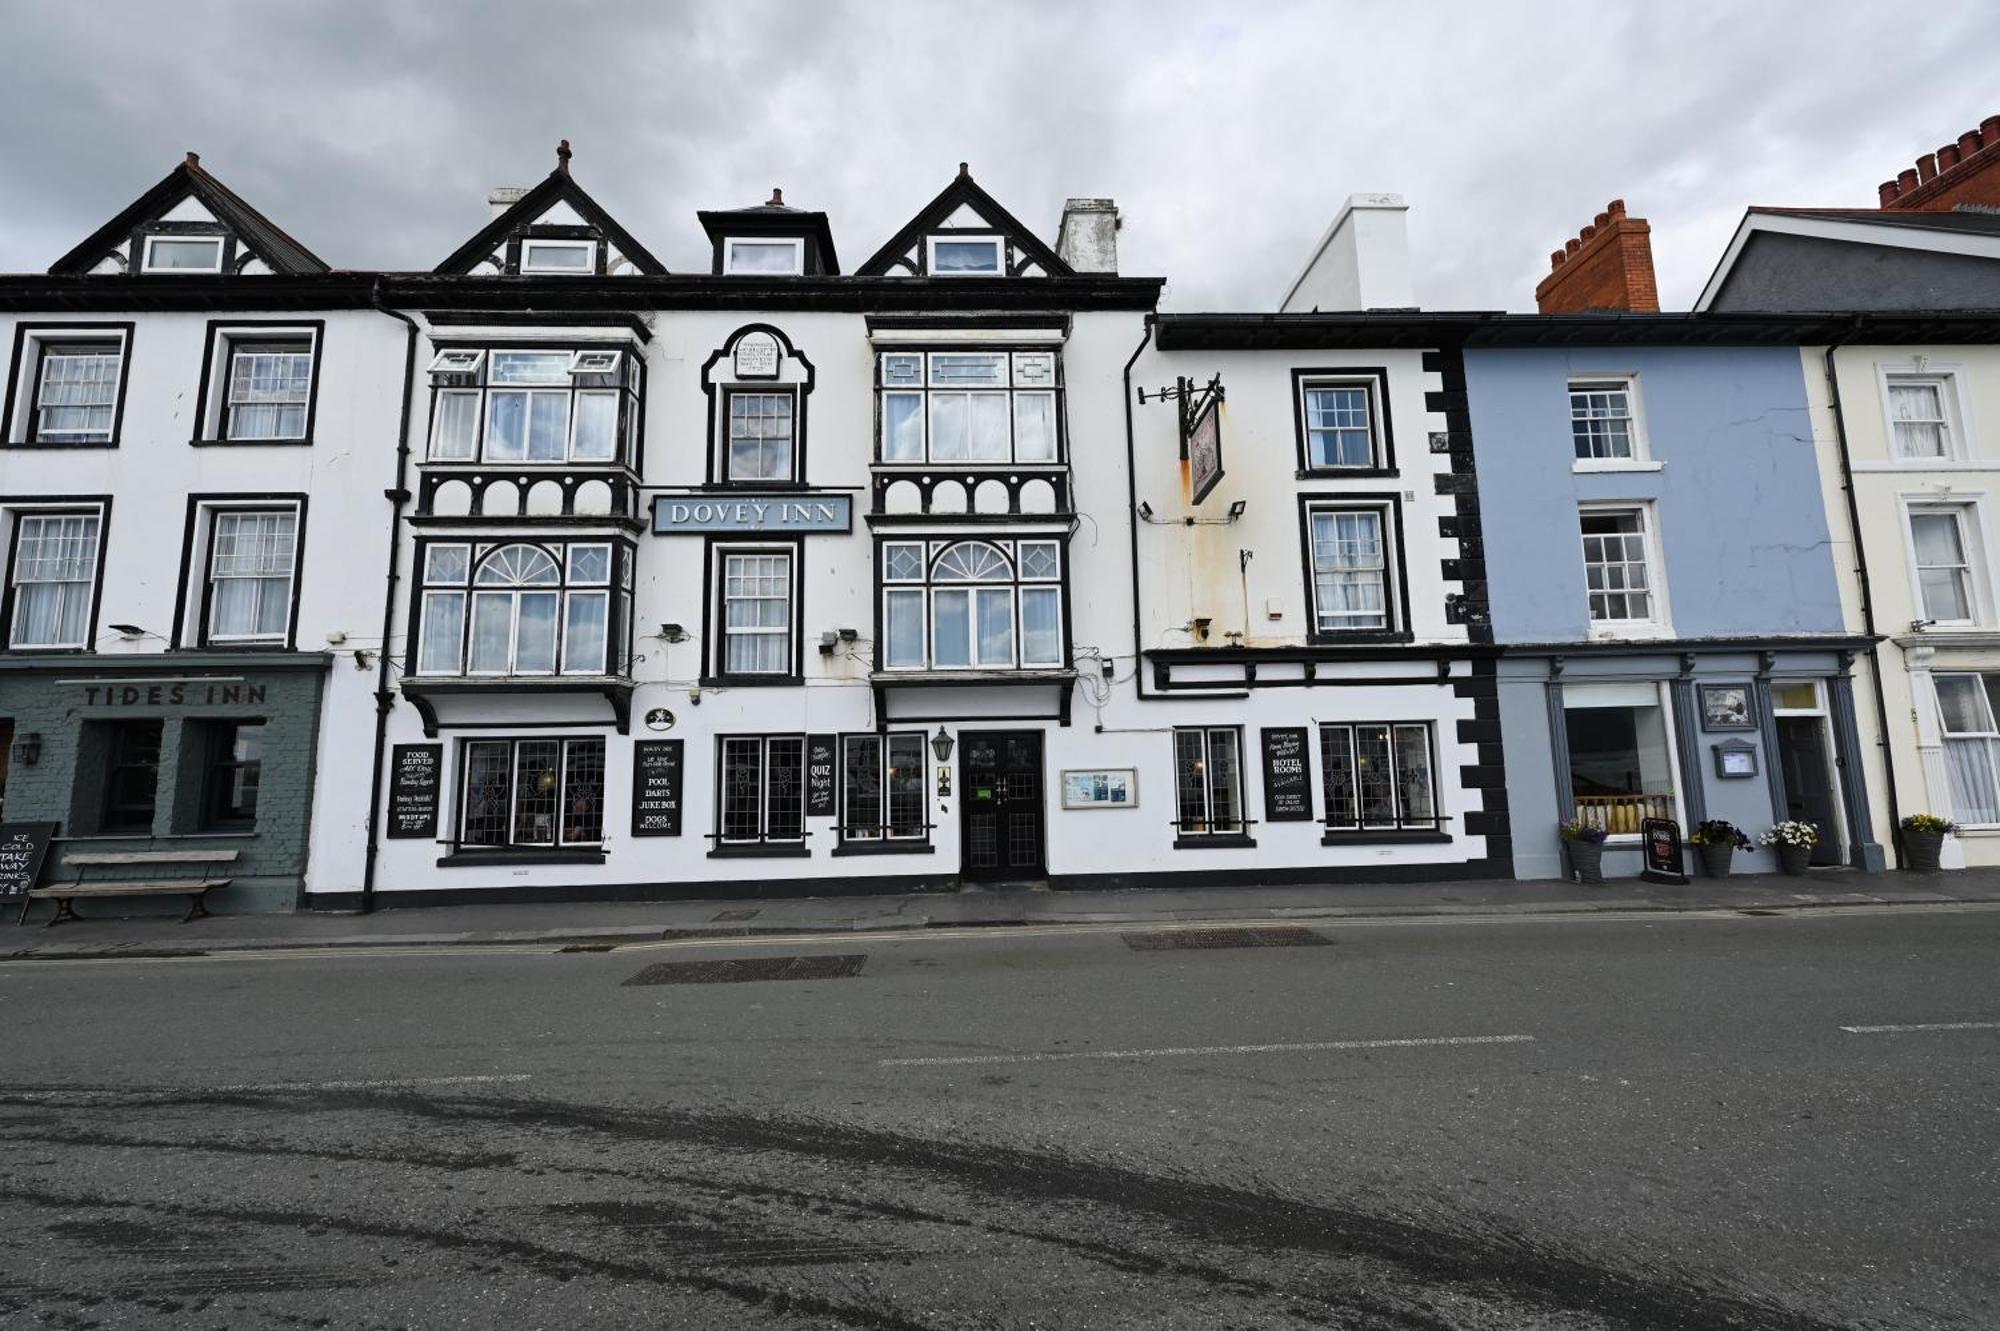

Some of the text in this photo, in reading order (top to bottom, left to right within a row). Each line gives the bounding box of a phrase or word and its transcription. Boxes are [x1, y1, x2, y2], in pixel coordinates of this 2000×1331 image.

[671, 503, 836, 523] DOVEY INN
[85, 684, 267, 706] TIDES INN
[1272, 759, 1302, 767] HOTEL
[810, 765, 831, 778] QUIZ
[648, 778, 670, 786] POOL
[811, 777, 831, 789] Night
[645, 789, 671, 797] DARTS
[639, 801, 676, 809] JUKE BOX
[645, 815, 668, 824] DOGS
[14, 833, 29, 842] ICE
[2, 843, 34, 851] COLD
[0, 852, 33, 861] TAKE
[0, 861, 29, 871] WAY
